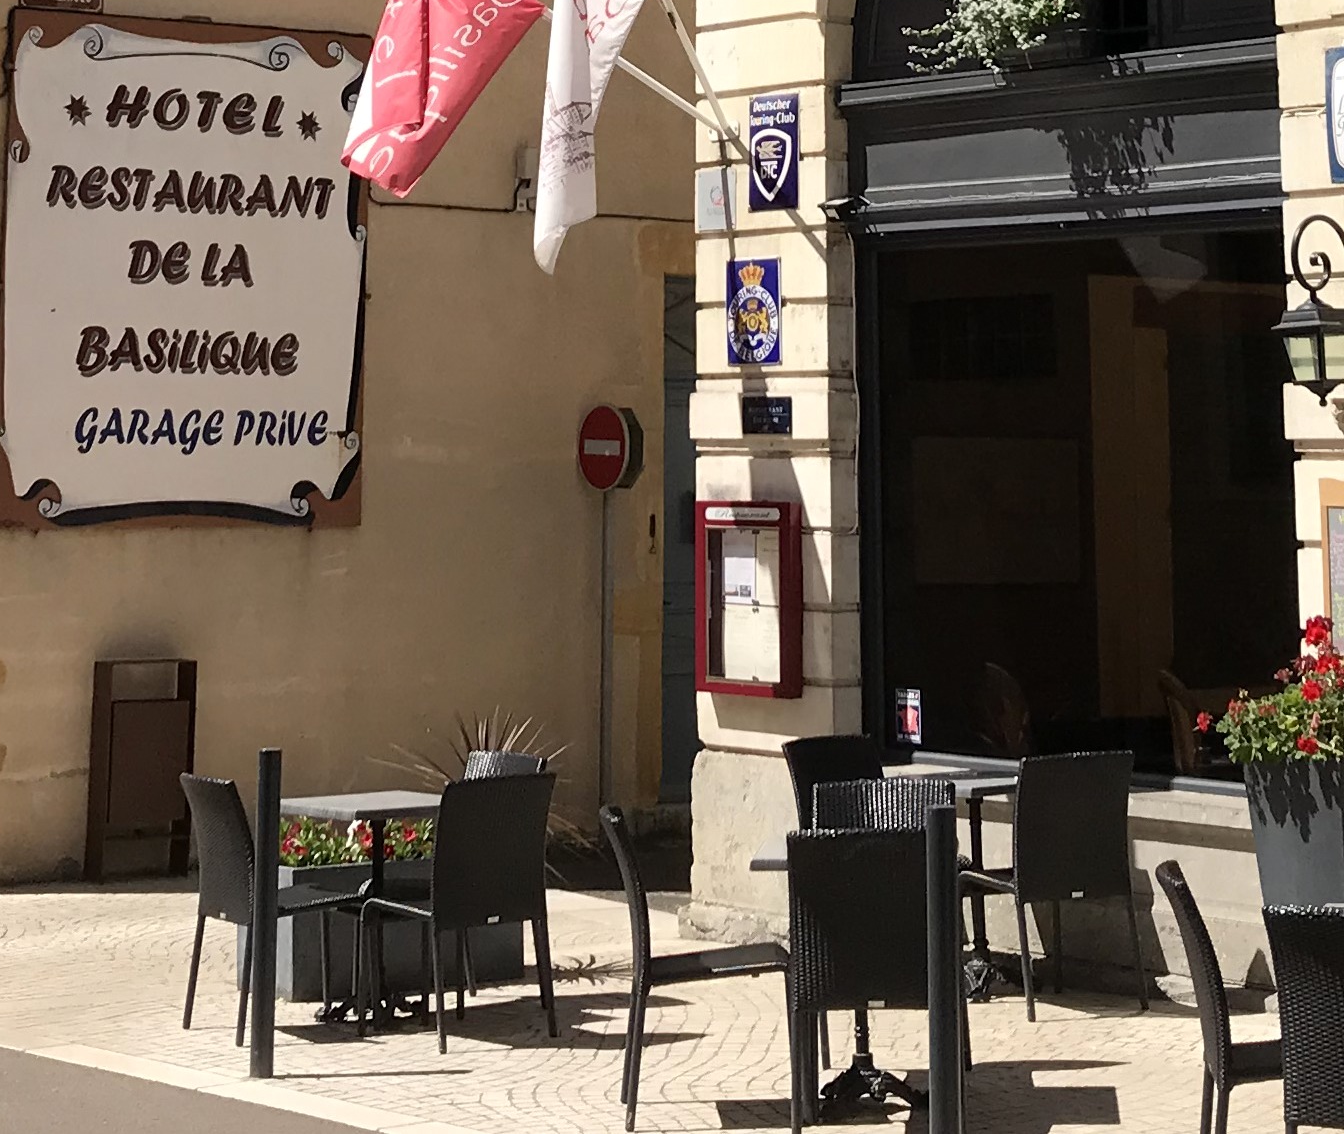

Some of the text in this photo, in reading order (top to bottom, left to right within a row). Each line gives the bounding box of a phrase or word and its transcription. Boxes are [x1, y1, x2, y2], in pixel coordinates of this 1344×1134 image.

[106, 84, 285, 138] HOTEL
[753, 99, 792, 113] Deutscher
[46, 164, 336, 220] RESTAURANT
[760, 161, 778, 179] DTC
[127, 239, 255, 287] DE LA
[74, 406, 224, 455] GARAGE
